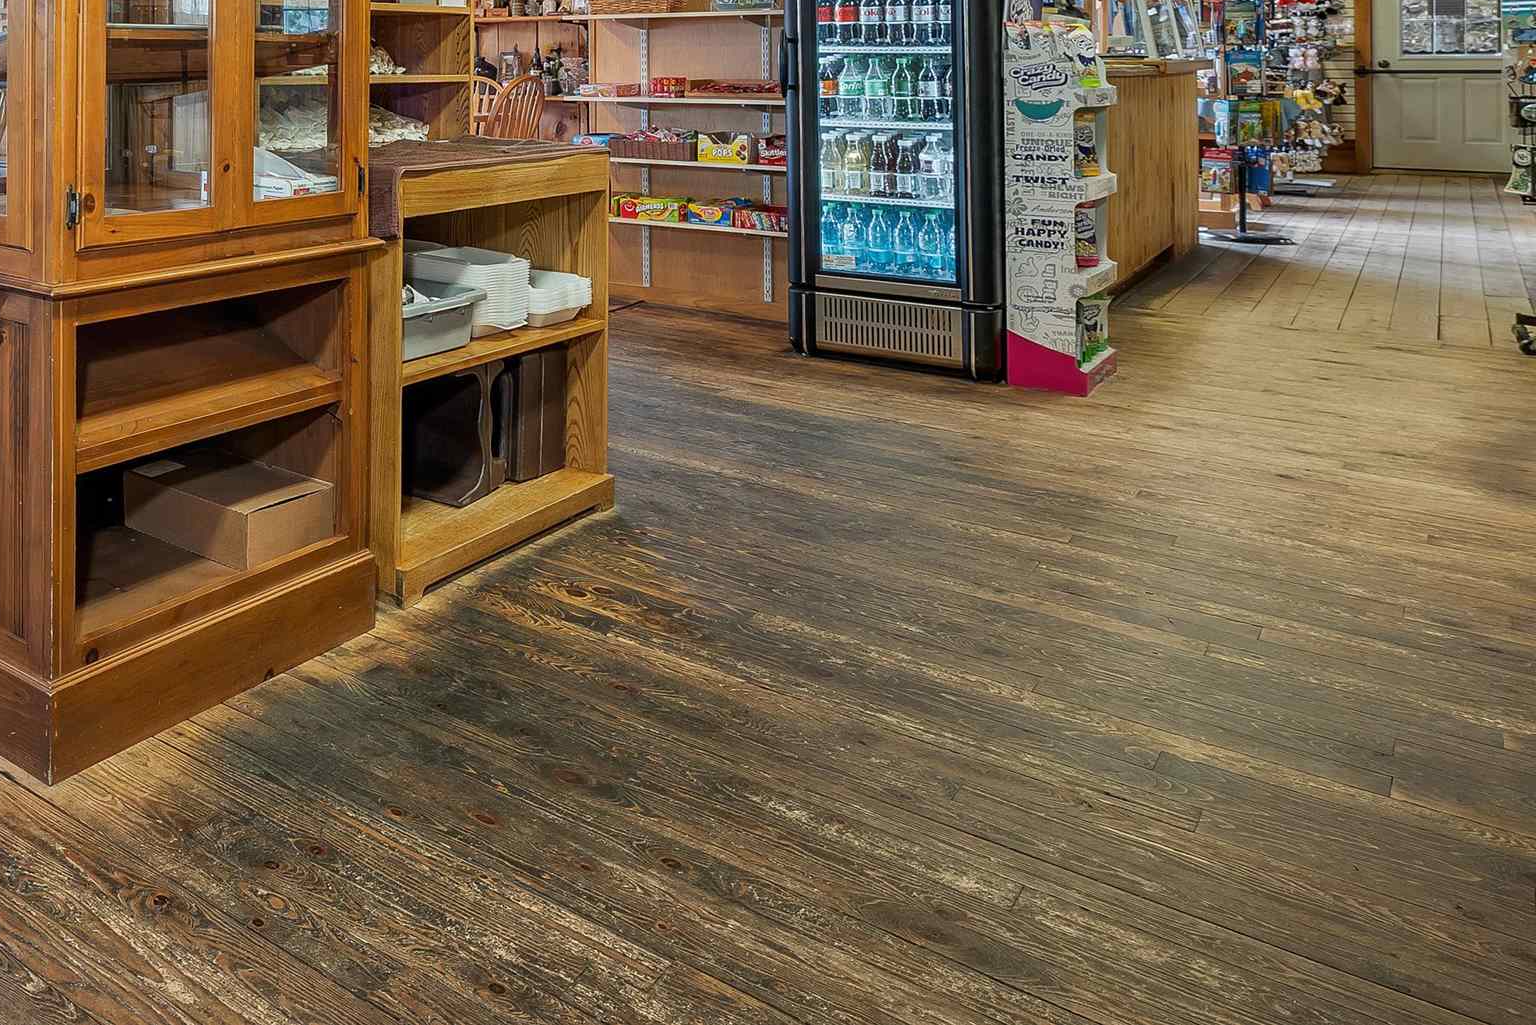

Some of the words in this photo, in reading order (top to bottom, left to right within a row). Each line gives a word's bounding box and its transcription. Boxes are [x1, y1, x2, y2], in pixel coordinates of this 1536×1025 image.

[1010, 63, 1056, 78] Crazy
[1018, 71, 1068, 87] Candy
[1021, 138, 1072, 147] UNIQUE
[712, 149, 733, 157] POPS
[1011, 153, 1069, 162] CANDY
[1012, 175, 1070, 185] TWIST
[1047, 191, 1084, 200] RIGHT
[1018, 239, 1065, 250] CANDY!
